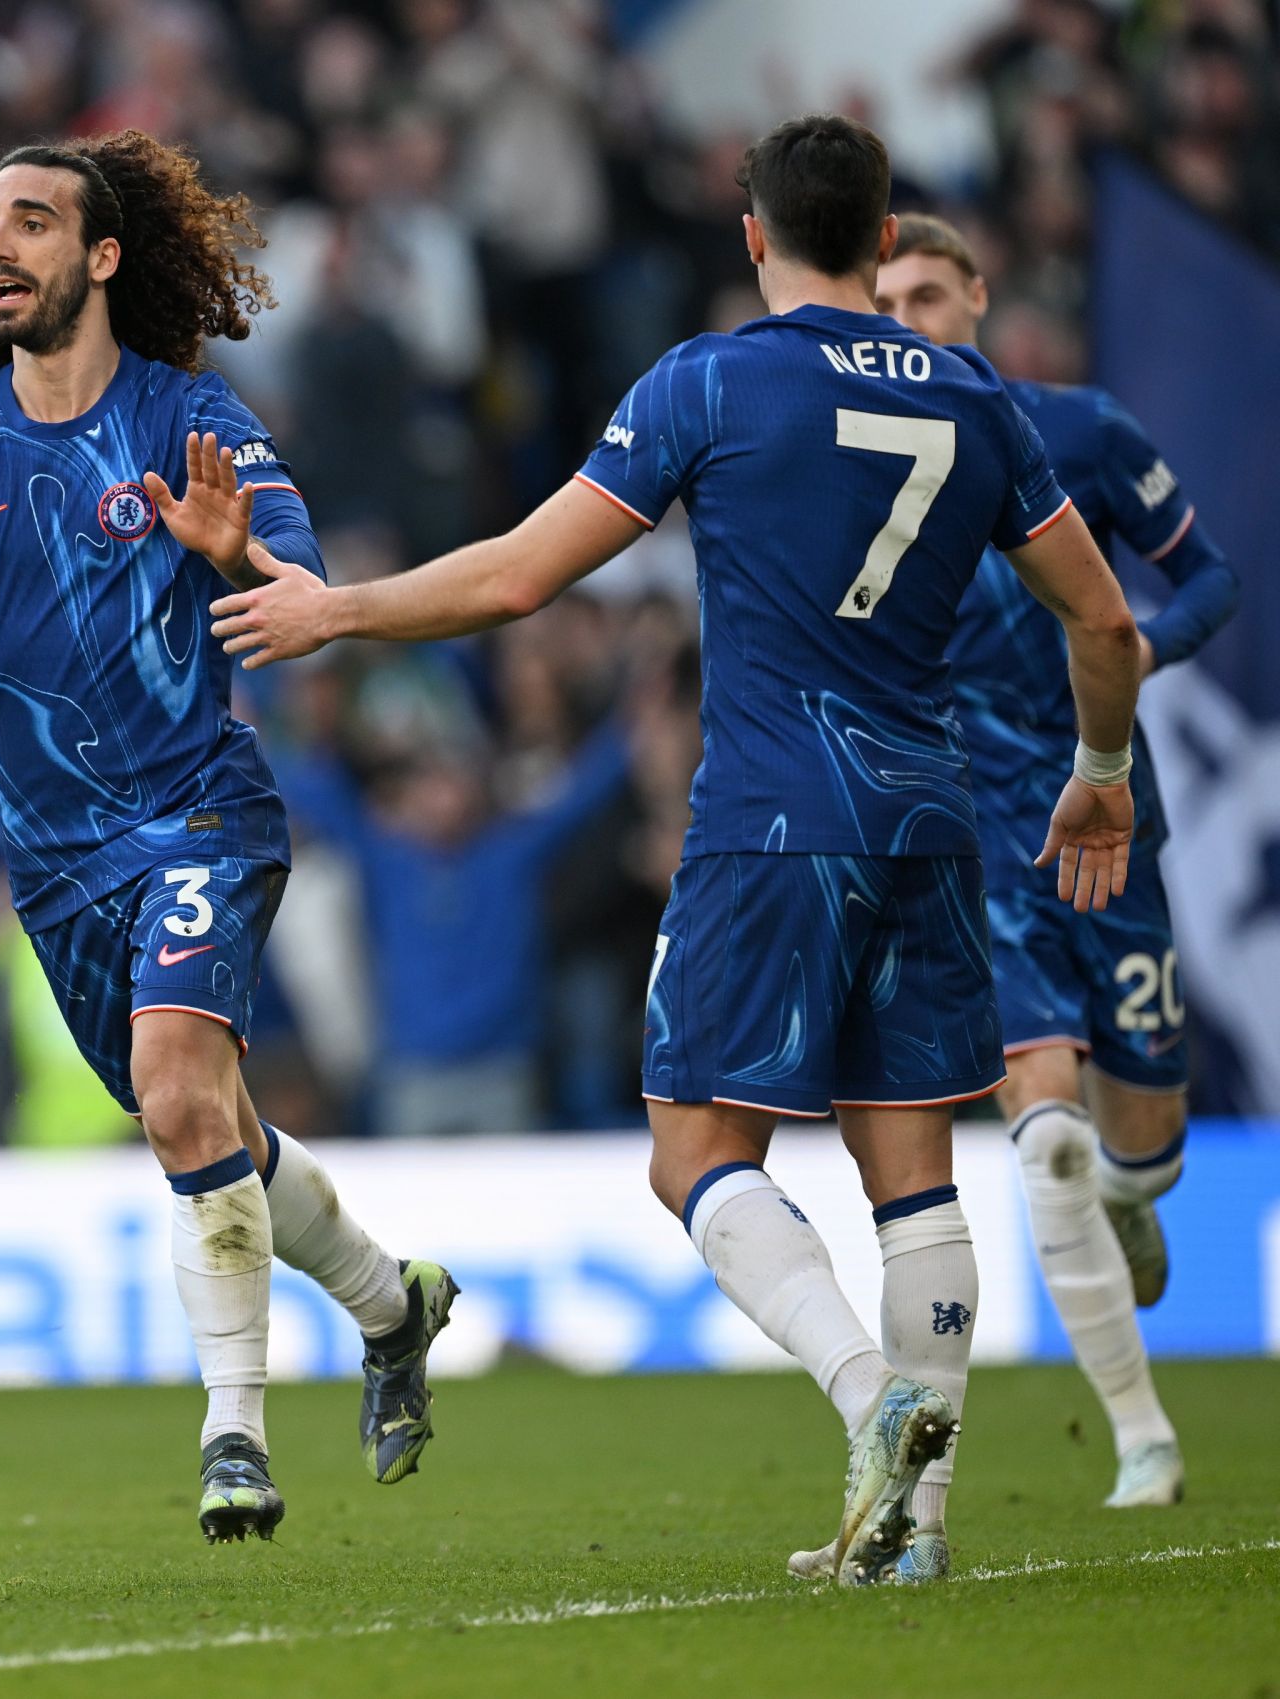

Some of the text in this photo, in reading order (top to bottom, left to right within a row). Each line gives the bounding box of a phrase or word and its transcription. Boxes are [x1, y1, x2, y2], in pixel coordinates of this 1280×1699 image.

[820, 341, 931, 381] NETO
[109, 484, 144, 498] CHELSEA
[835, 408, 955, 619] 7
[163, 867, 213, 937] 3
